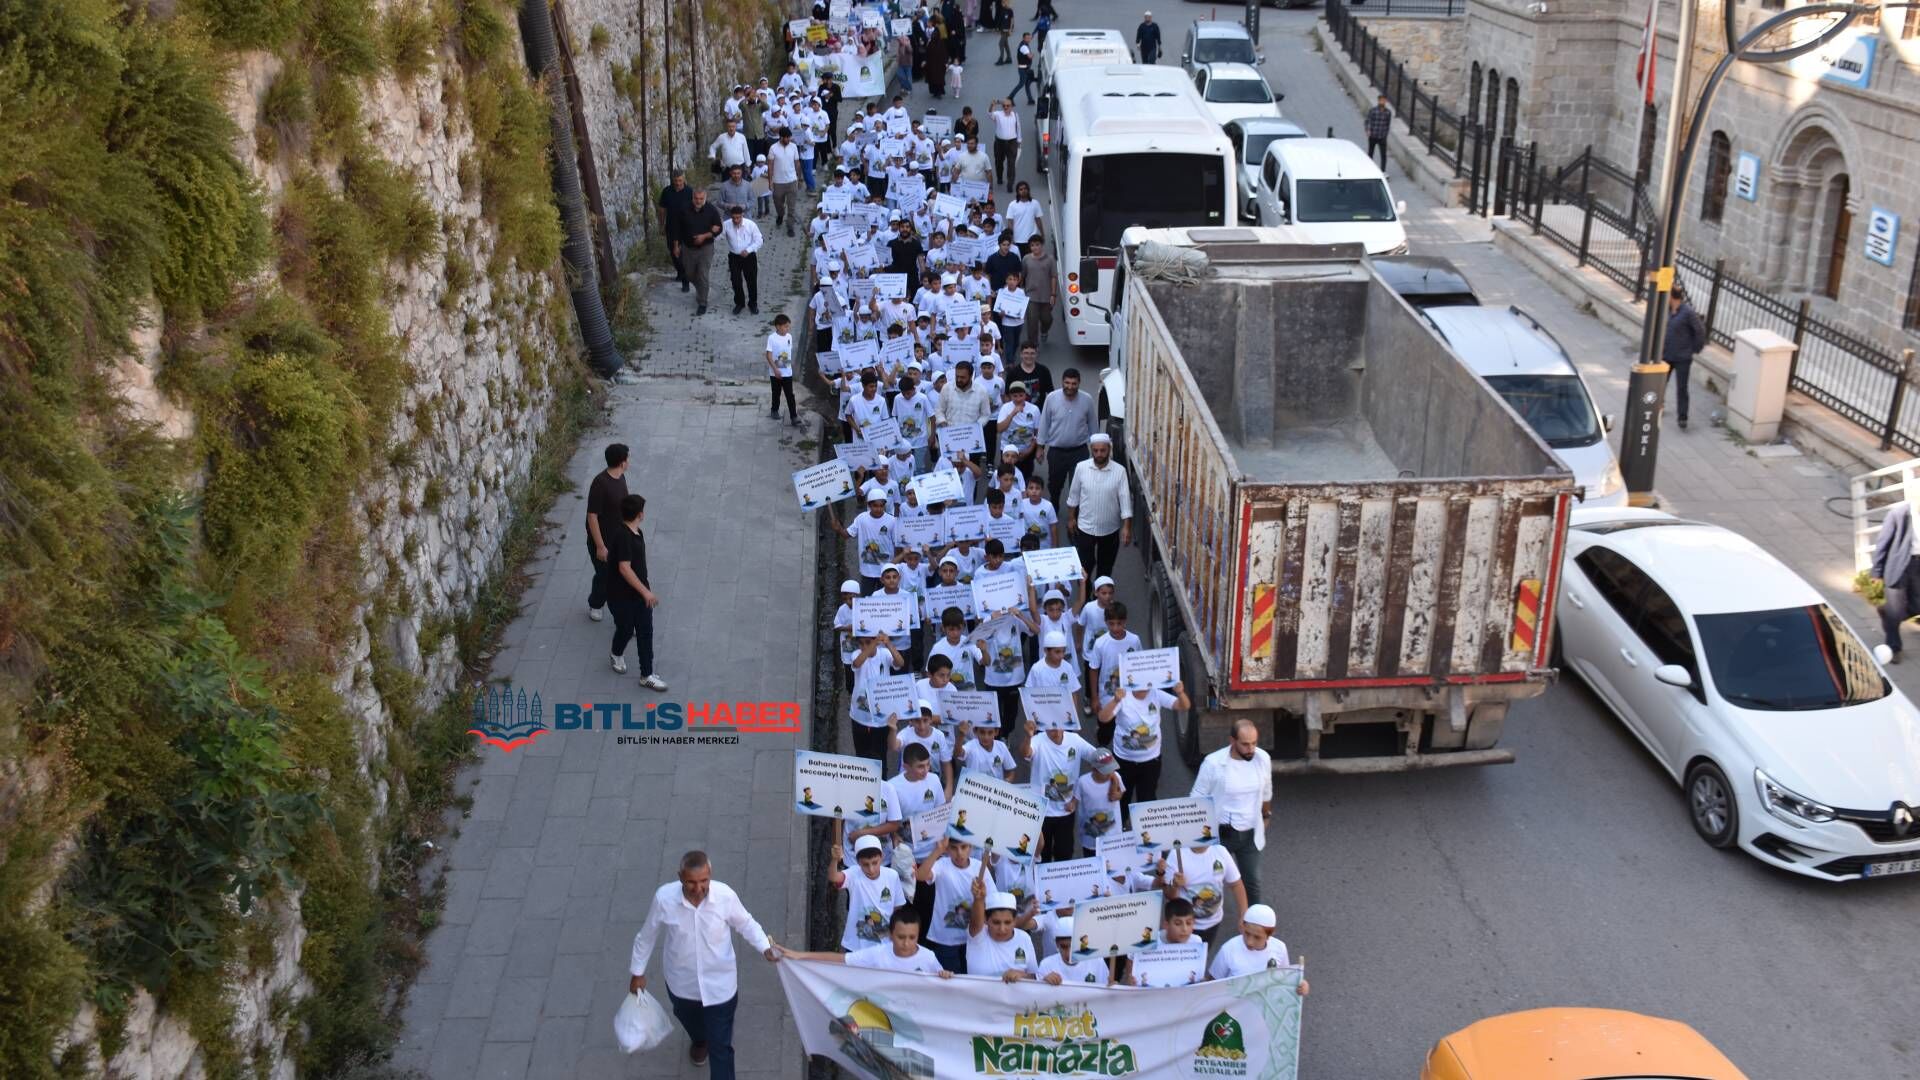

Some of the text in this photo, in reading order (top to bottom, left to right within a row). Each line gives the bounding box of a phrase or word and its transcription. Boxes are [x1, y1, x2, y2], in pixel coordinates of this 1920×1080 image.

[799, 768, 877, 783] seccadeyi terketme!
[808, 759, 869, 773] Bahane üretme,
[959, 787, 1040, 822] cennet kokan çocuk!
[964, 778, 1040, 812] Namaz kılan çocuk,
[1147, 804, 1178, 814] Oyunda
[1013, 1008, 1097, 1042] Hayat
[971, 1035, 1135, 1076] Namazla
[1194, 1059, 1247, 1068] PEYGAMBER
